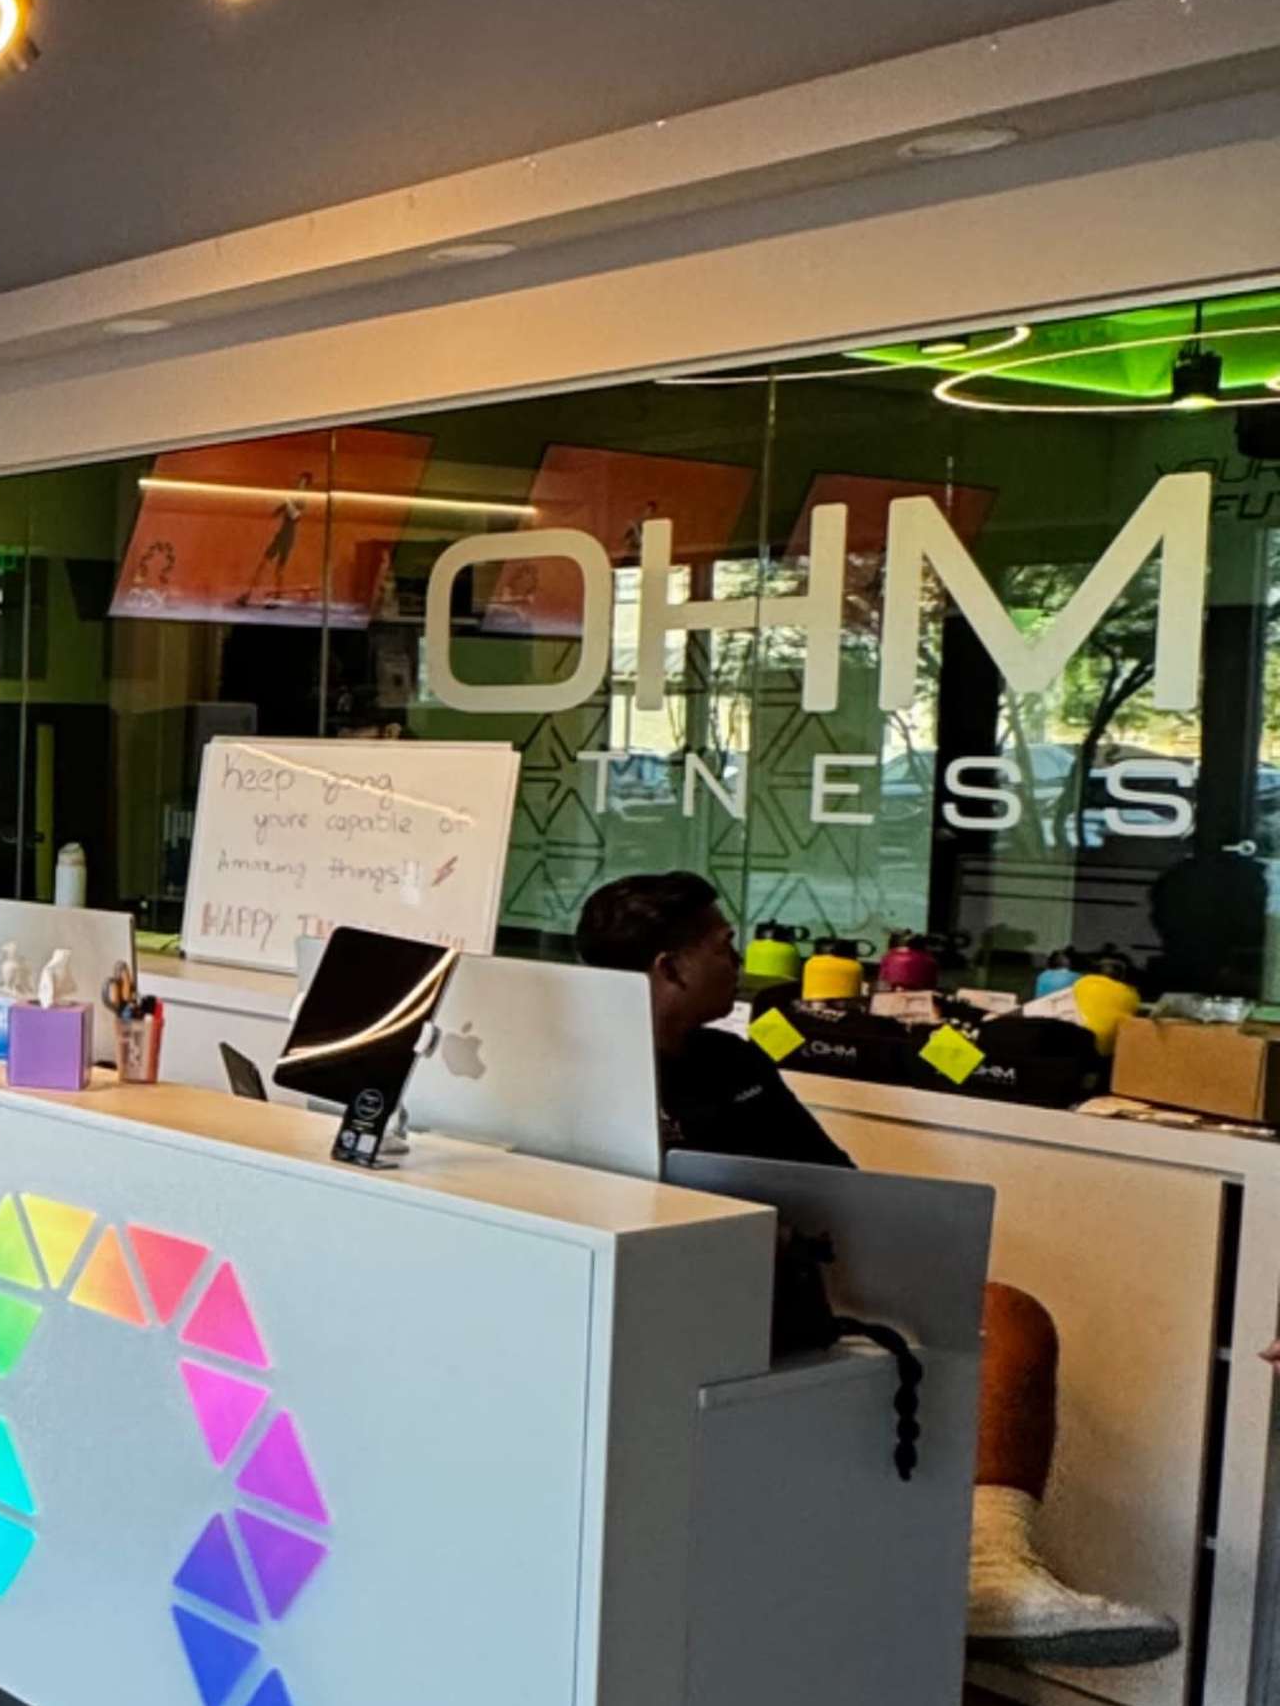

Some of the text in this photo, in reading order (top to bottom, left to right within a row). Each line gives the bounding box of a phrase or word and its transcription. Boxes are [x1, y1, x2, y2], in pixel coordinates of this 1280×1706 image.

[425, 471, 1212, 714] OHM
[222, 752, 296, 801] Keep
[325, 810, 413, 841] capable
[199, 901, 280, 952] HAPPY
